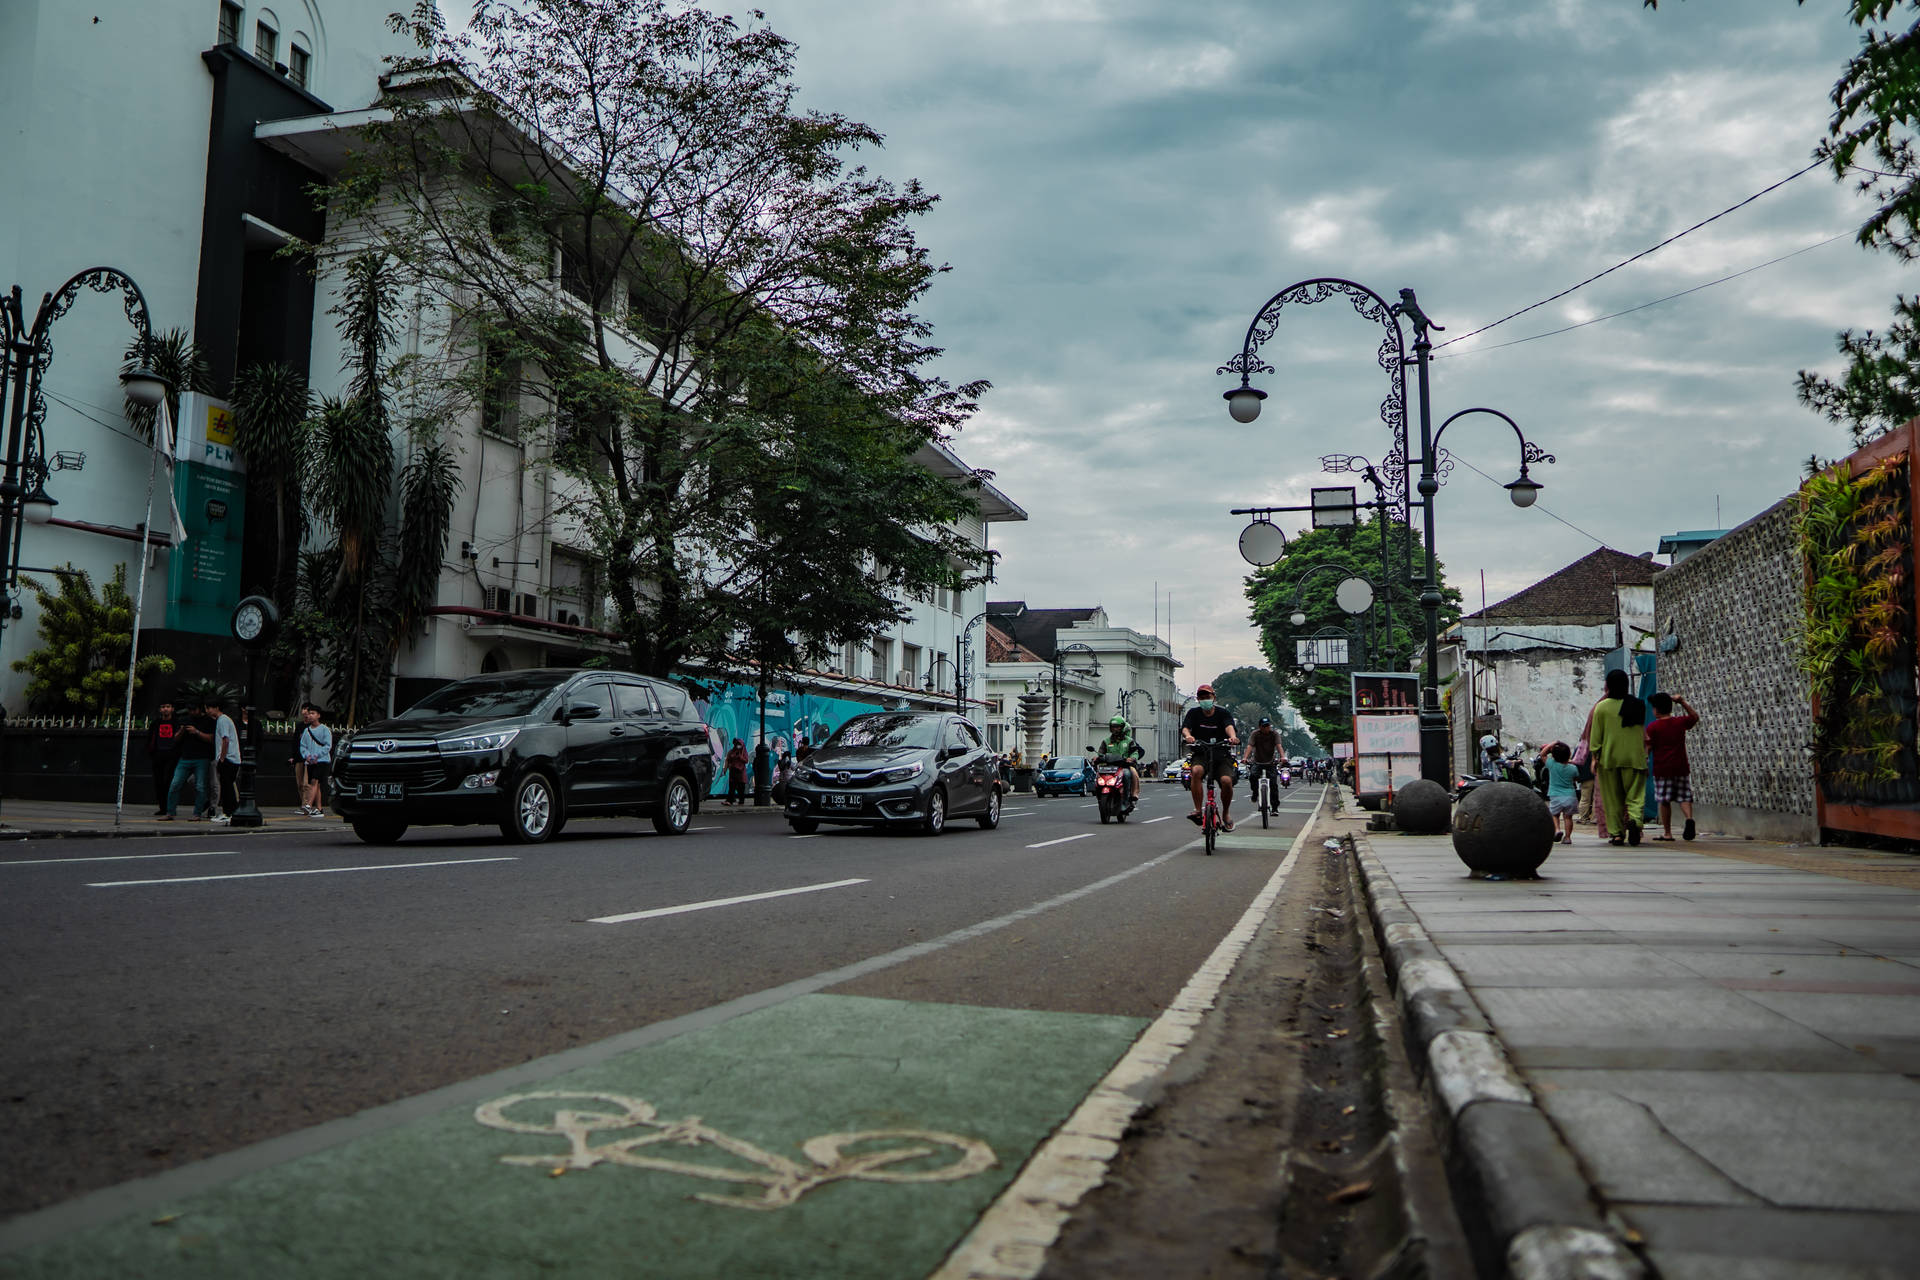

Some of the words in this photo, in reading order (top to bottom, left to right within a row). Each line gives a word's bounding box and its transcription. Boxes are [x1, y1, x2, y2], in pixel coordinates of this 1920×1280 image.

[206, 445, 234, 463] PLN
[357, 783, 363, 794] D
[370, 783, 386, 794] 1149
